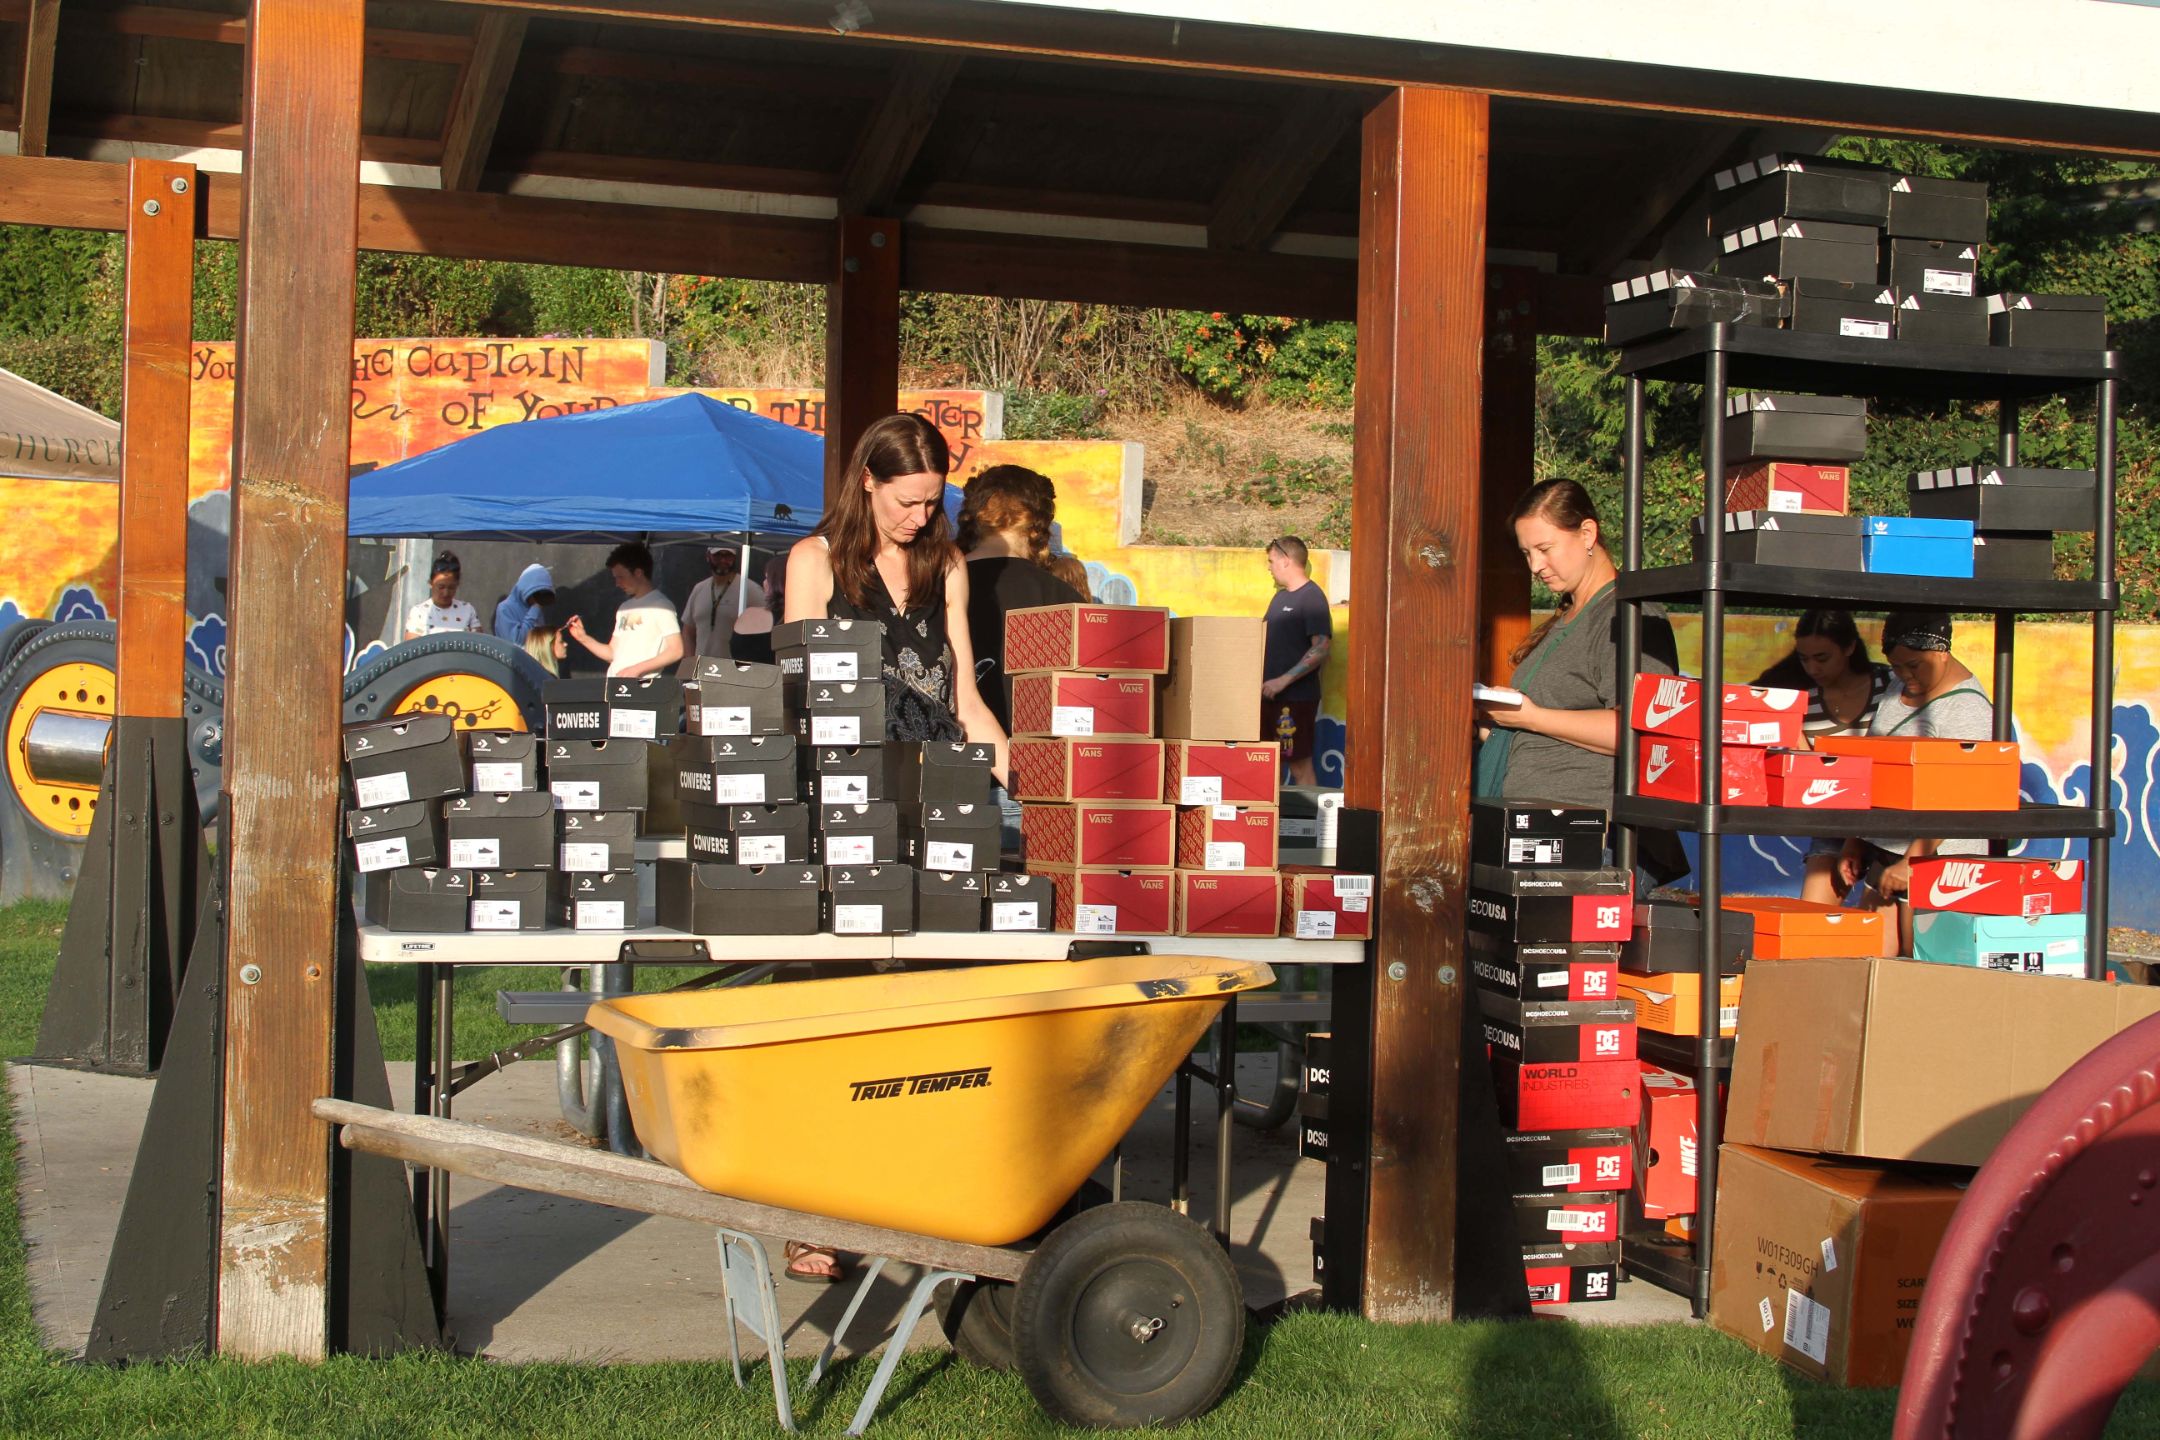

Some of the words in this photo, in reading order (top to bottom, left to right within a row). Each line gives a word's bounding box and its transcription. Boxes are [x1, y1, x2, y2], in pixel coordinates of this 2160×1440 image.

[352, 345, 394, 381] HE
[770, 399, 825, 431] TH
[1818, 471, 1841, 481] VANS
[1084, 613, 1109, 624] VANS
[1119, 682, 1145, 694] VANS
[1654, 678, 1687, 708] NIKE
[556, 712, 600, 729] CONVERSE
[1078, 747, 1103, 758] VANS
[1246, 751, 1271, 763] VANS
[1650, 744, 1669, 767] NIKE
[680, 771, 711, 791] CONVERSE
[1809, 779, 1840, 794] NIKE
[1088, 813, 1114, 824] VANS
[1245, 816, 1269, 826] VANS
[693, 834, 729, 855] CONVERSE
[1939, 861, 1986, 888] NIKE
[1139, 879, 1164, 890] VANS
[1193, 879, 1218, 890] VANS
[1470, 899, 1507, 921] ECOUSA
[1473, 960, 1517, 987] HOECOUSA
[1524, 1068, 1578, 1079] WORLD
[849, 1077, 907, 1101] TRUE
[907, 1066, 992, 1096] TEMPER
[1523, 1079, 1590, 1092] INDUSTRIES
[1307, 1128, 1328, 1148] DCSH
[1757, 1236, 1819, 1278] W01F309GH
[1896, 1278, 1926, 1289] SCAR
